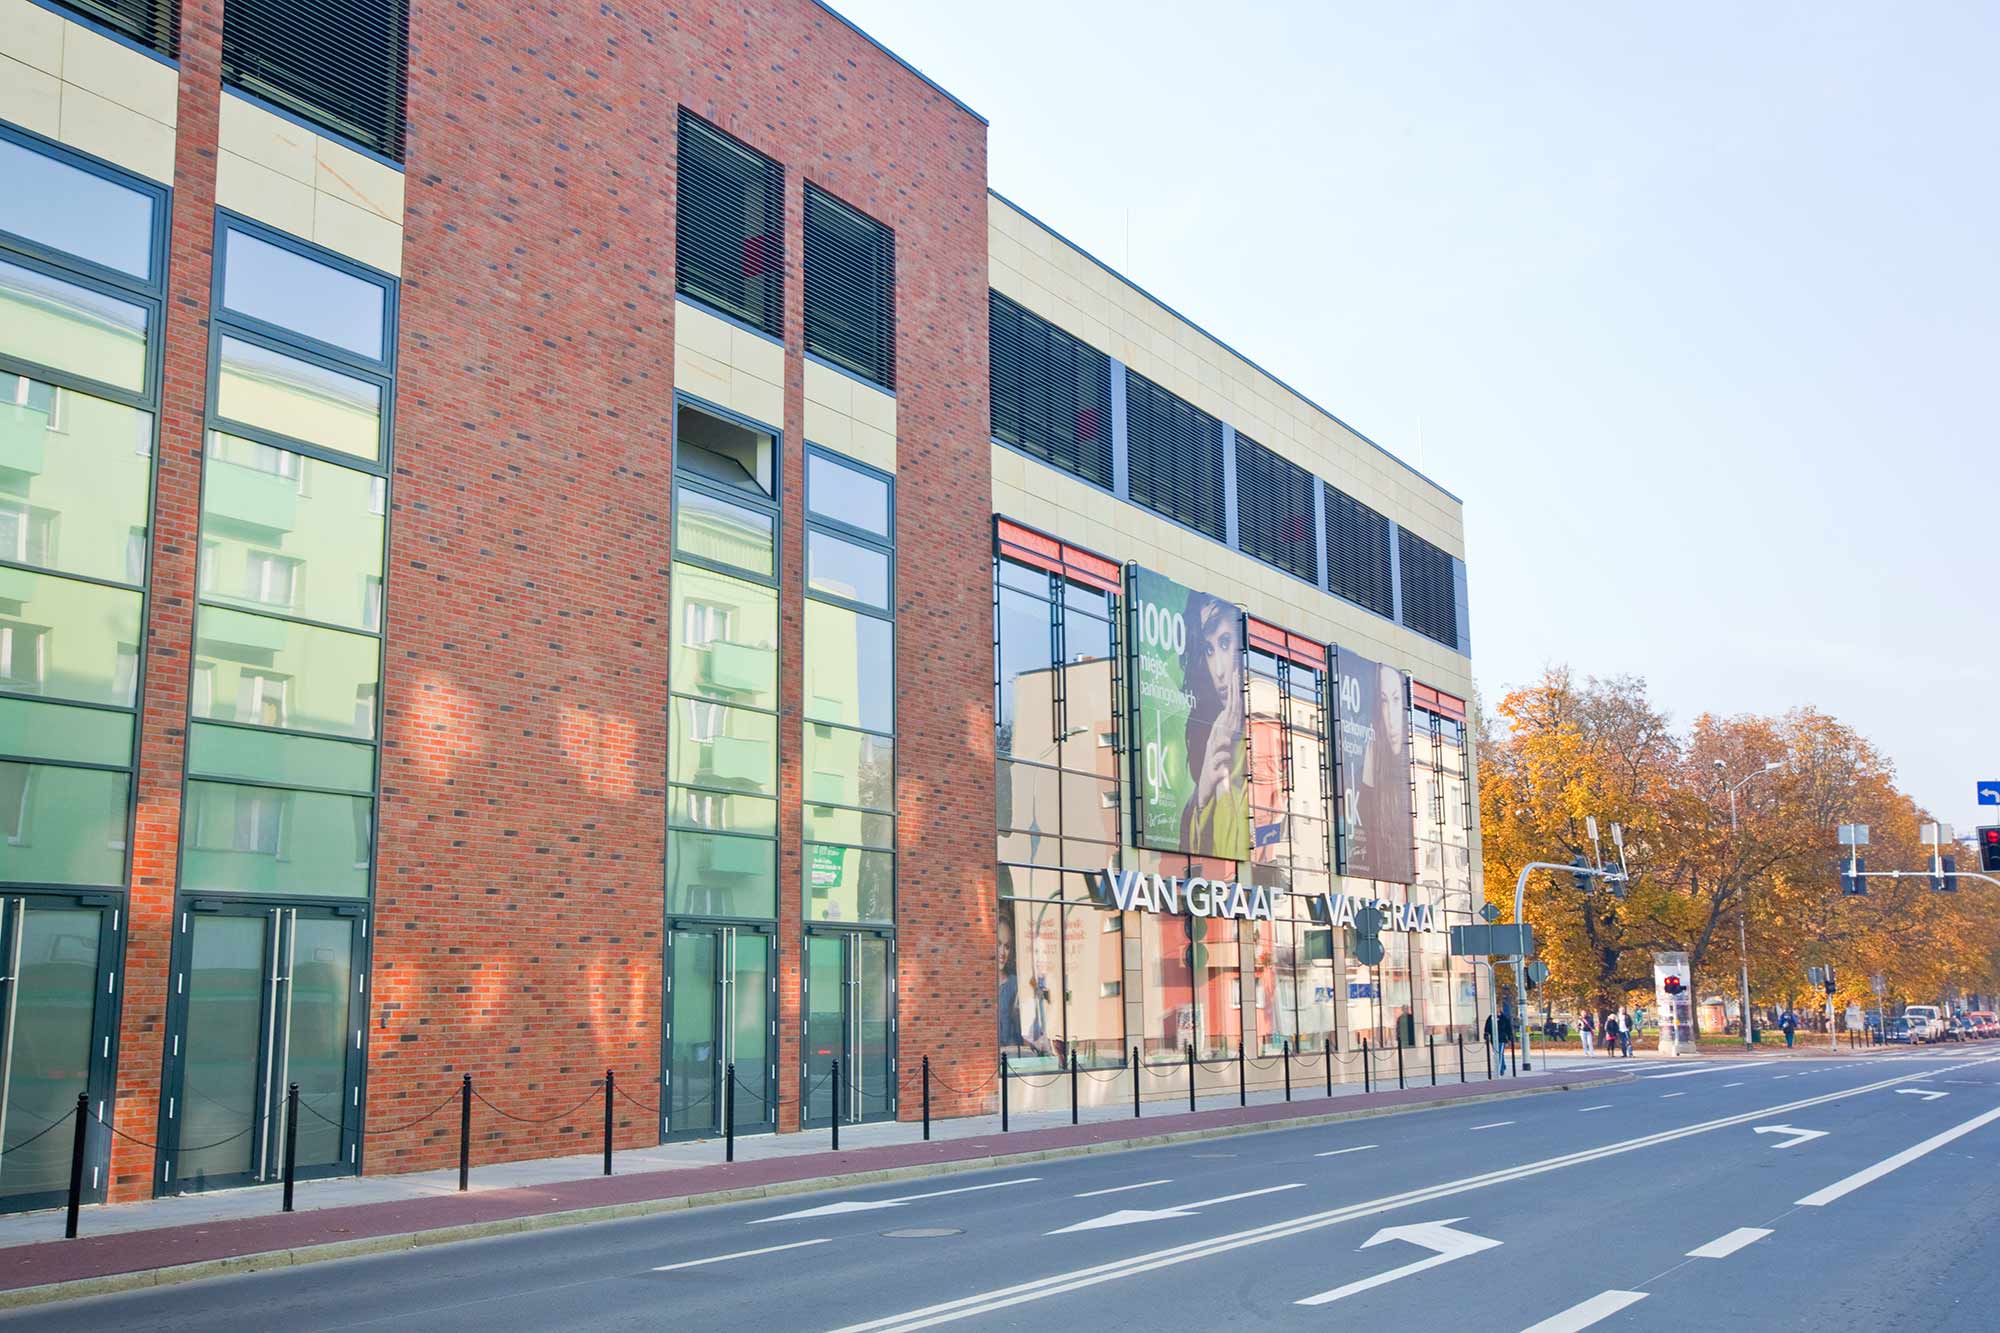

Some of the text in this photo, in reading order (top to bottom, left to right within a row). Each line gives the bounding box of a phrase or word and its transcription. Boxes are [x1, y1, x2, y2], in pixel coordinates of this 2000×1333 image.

[1138, 599, 1186, 655] 1000
[1341, 675, 1360, 713] 40
[1105, 864, 1284, 920] VAN GRAAF
